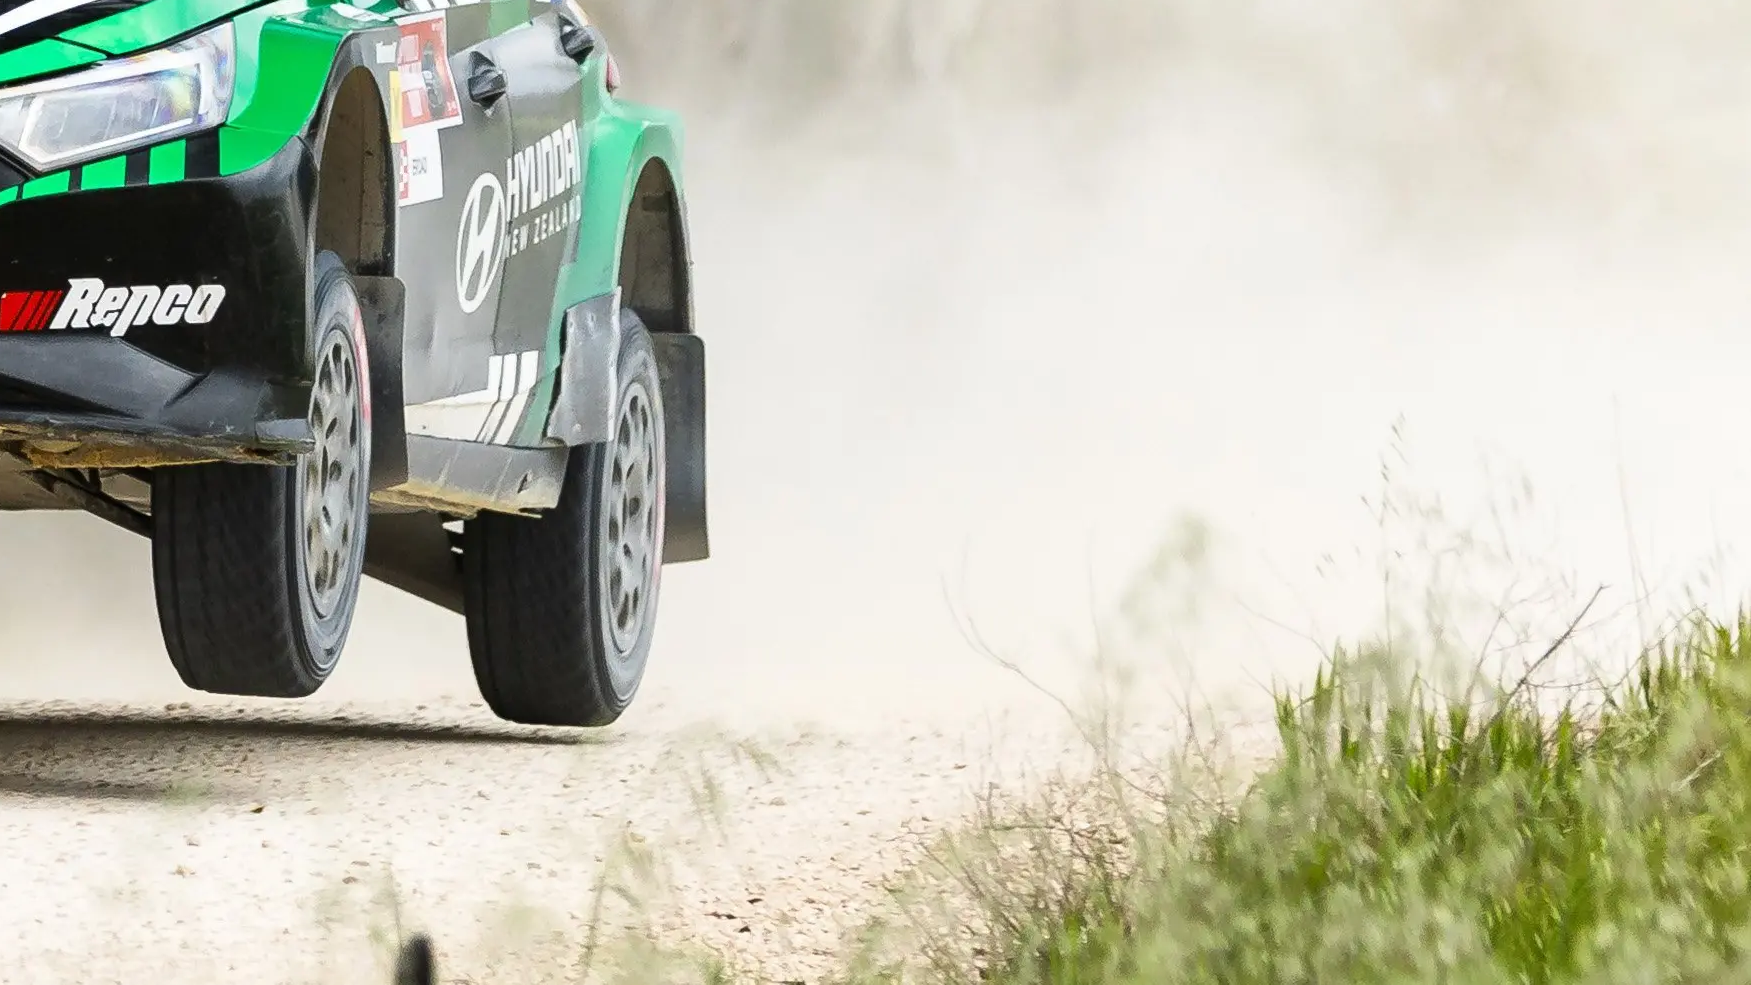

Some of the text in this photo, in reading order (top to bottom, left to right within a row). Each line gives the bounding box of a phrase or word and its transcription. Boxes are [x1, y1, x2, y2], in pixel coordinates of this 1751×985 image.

[506, 119, 581, 223] HYUNDAI
[505, 195, 582, 258] NEW ZEALAND
[49, 277, 226, 337] Repco
